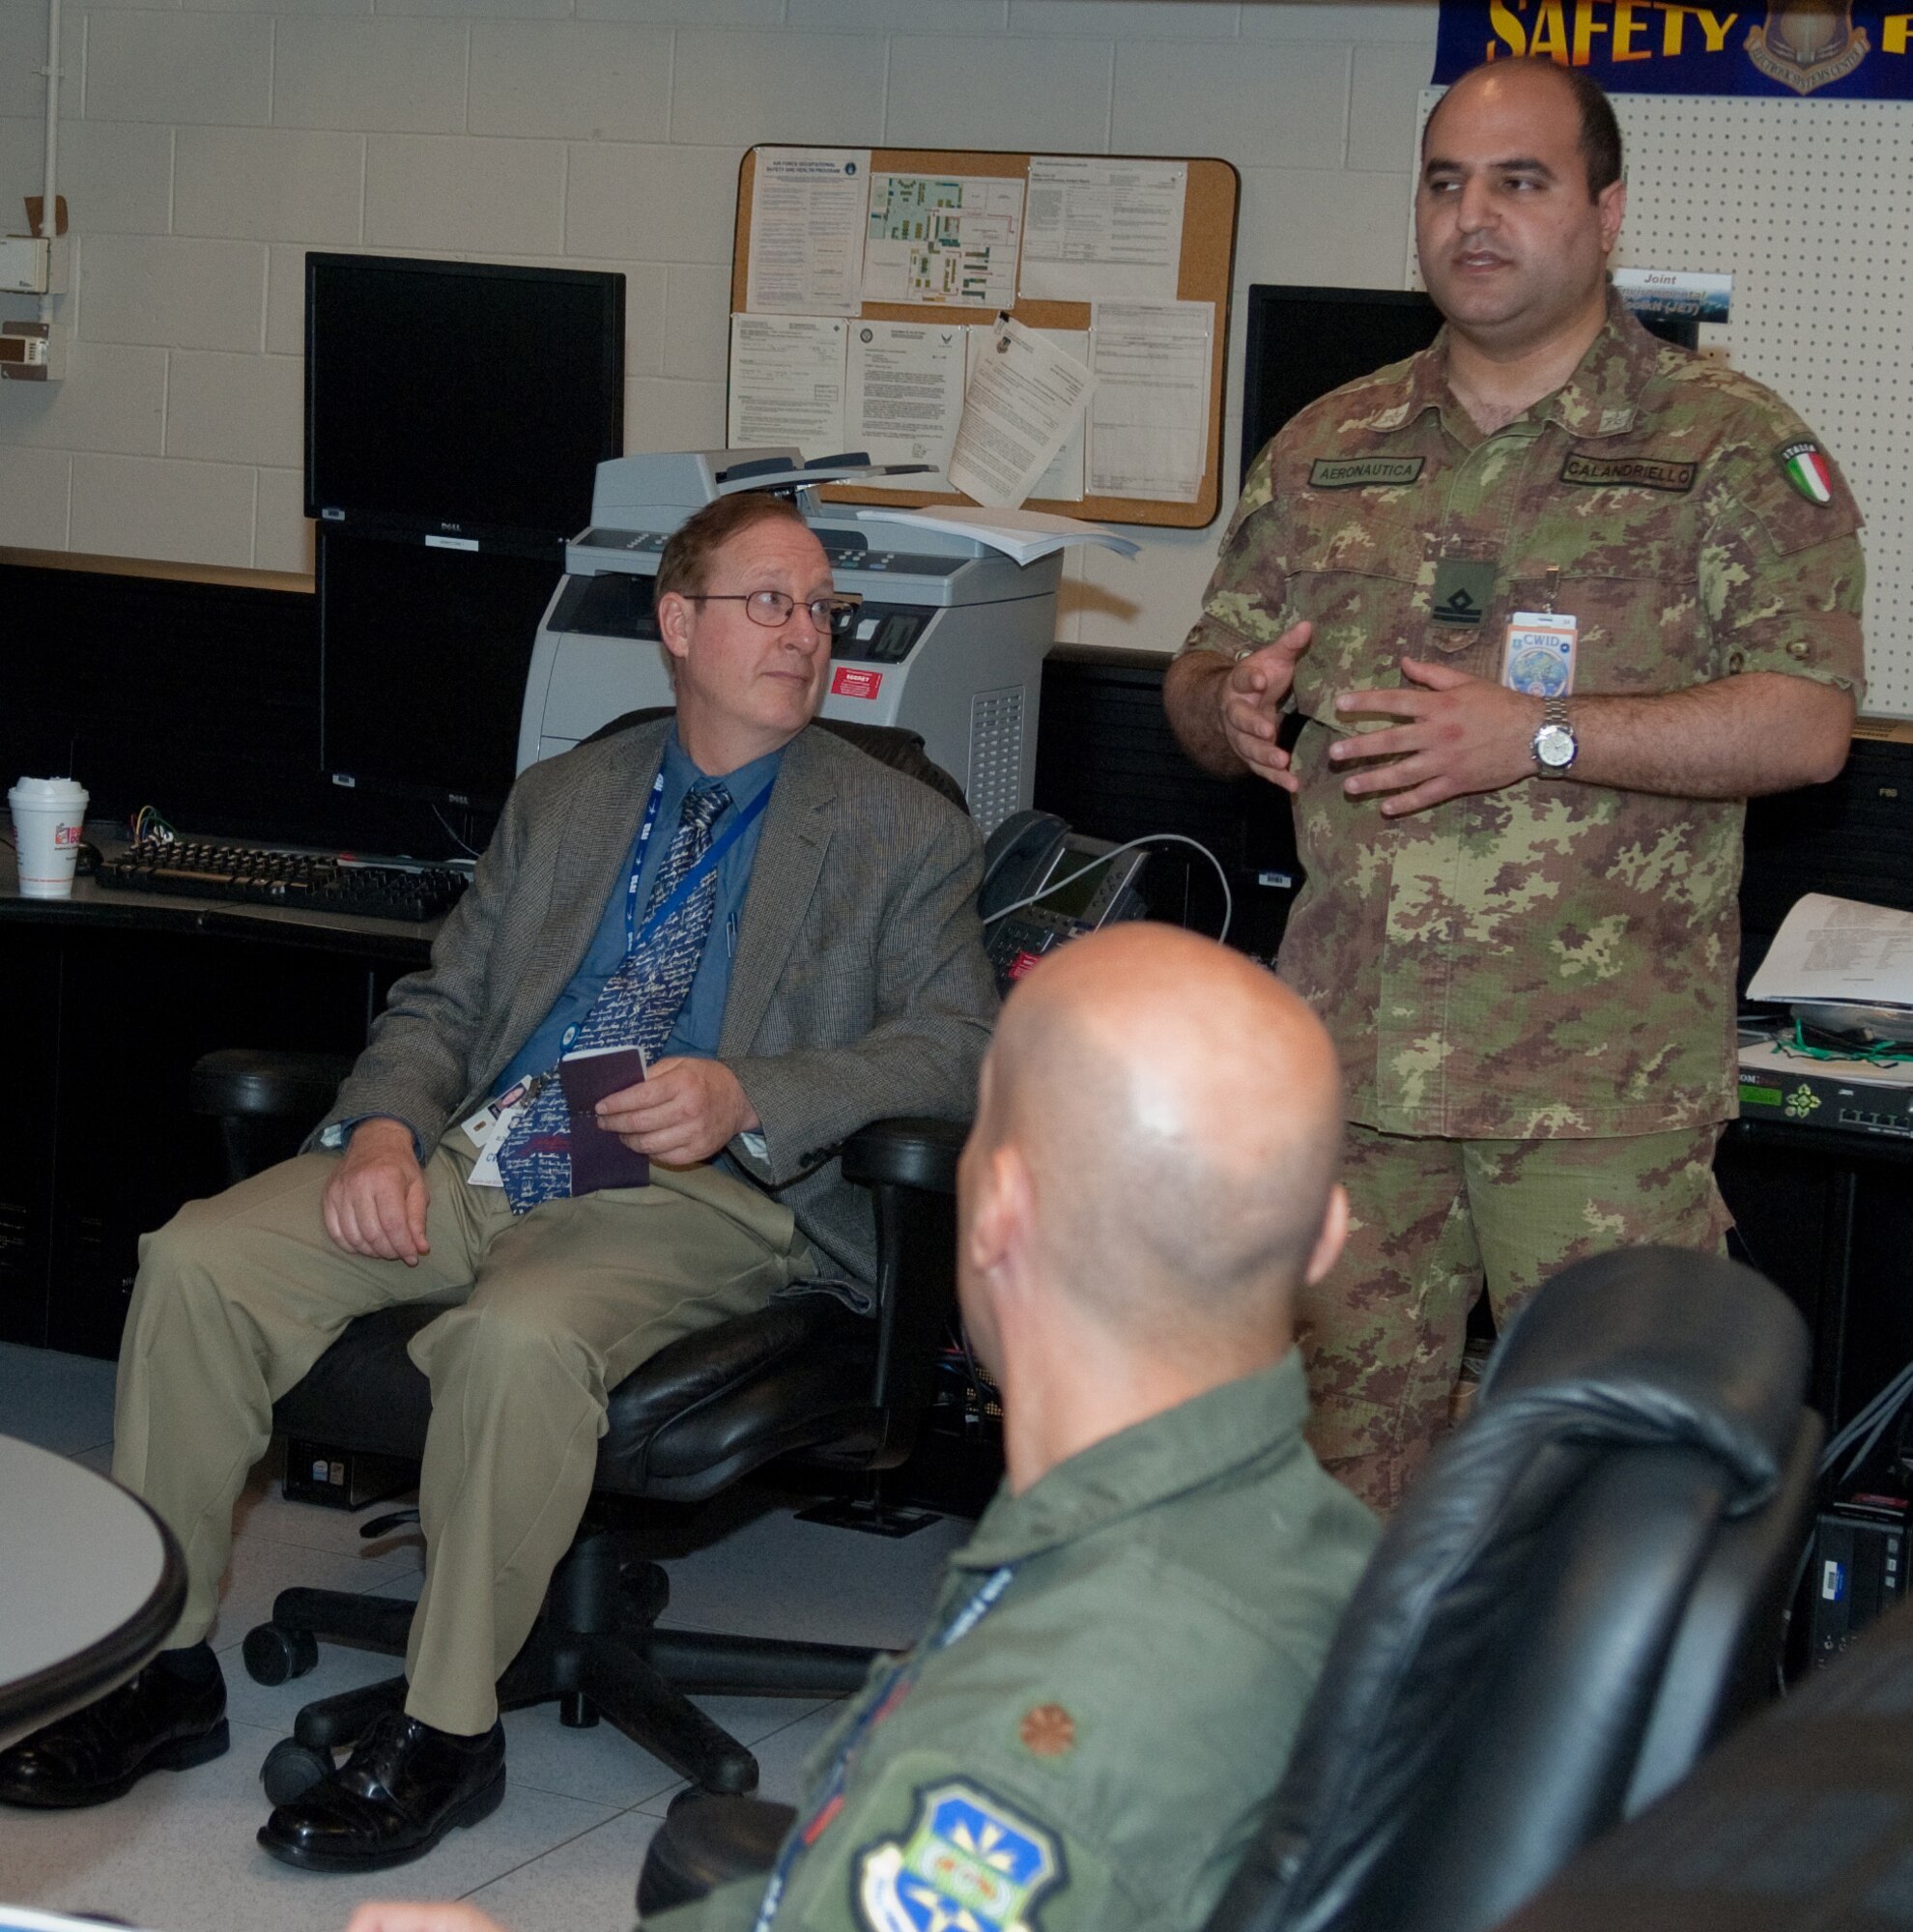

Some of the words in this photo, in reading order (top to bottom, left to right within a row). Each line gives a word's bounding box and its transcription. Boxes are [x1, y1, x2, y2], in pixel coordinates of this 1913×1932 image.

[1486, 0, 1738, 67] SAFETY
[1643, 273, 1677, 285] Joint
[1320, 464, 1412, 480] AERONAUTICA
[1567, 462, 1690, 483] CALANDRIELLO
[441, 523, 462, 531] DELL
[1524, 634, 1560, 646] CWID
